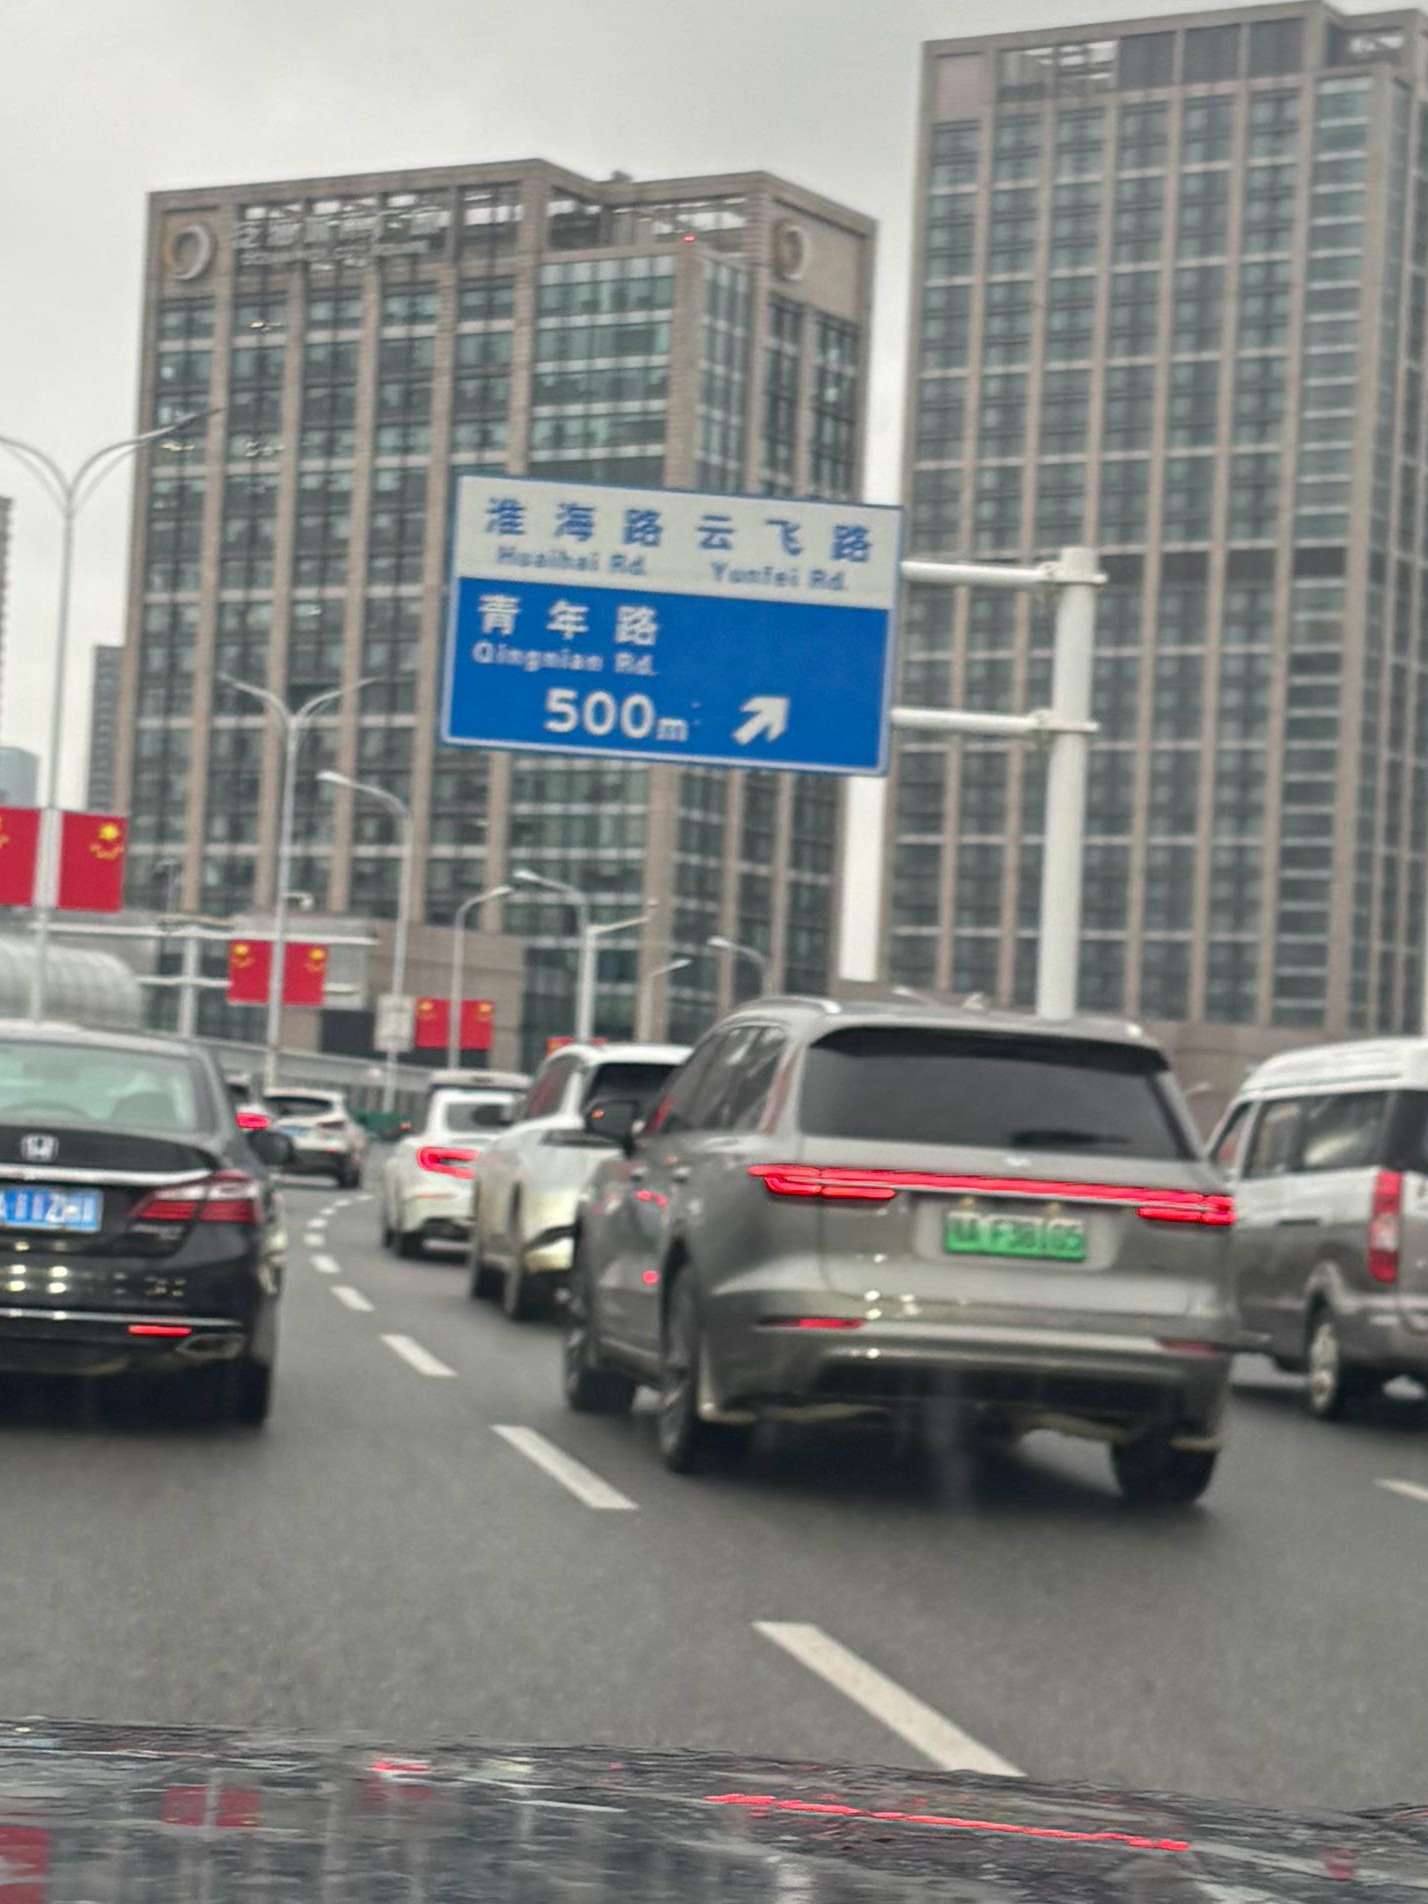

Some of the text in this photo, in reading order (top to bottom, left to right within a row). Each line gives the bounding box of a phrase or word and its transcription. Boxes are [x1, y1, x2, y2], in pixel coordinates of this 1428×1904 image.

[486, 497, 871, 563] 淮海路 云飞路
[496, 547, 599, 573] Huaihai
[712, 562, 799, 588] Yunfei
[478, 594, 659, 646] 青年路
[473, 641, 603, 672] Qingnian
[543, 687, 689, 741] 500m
